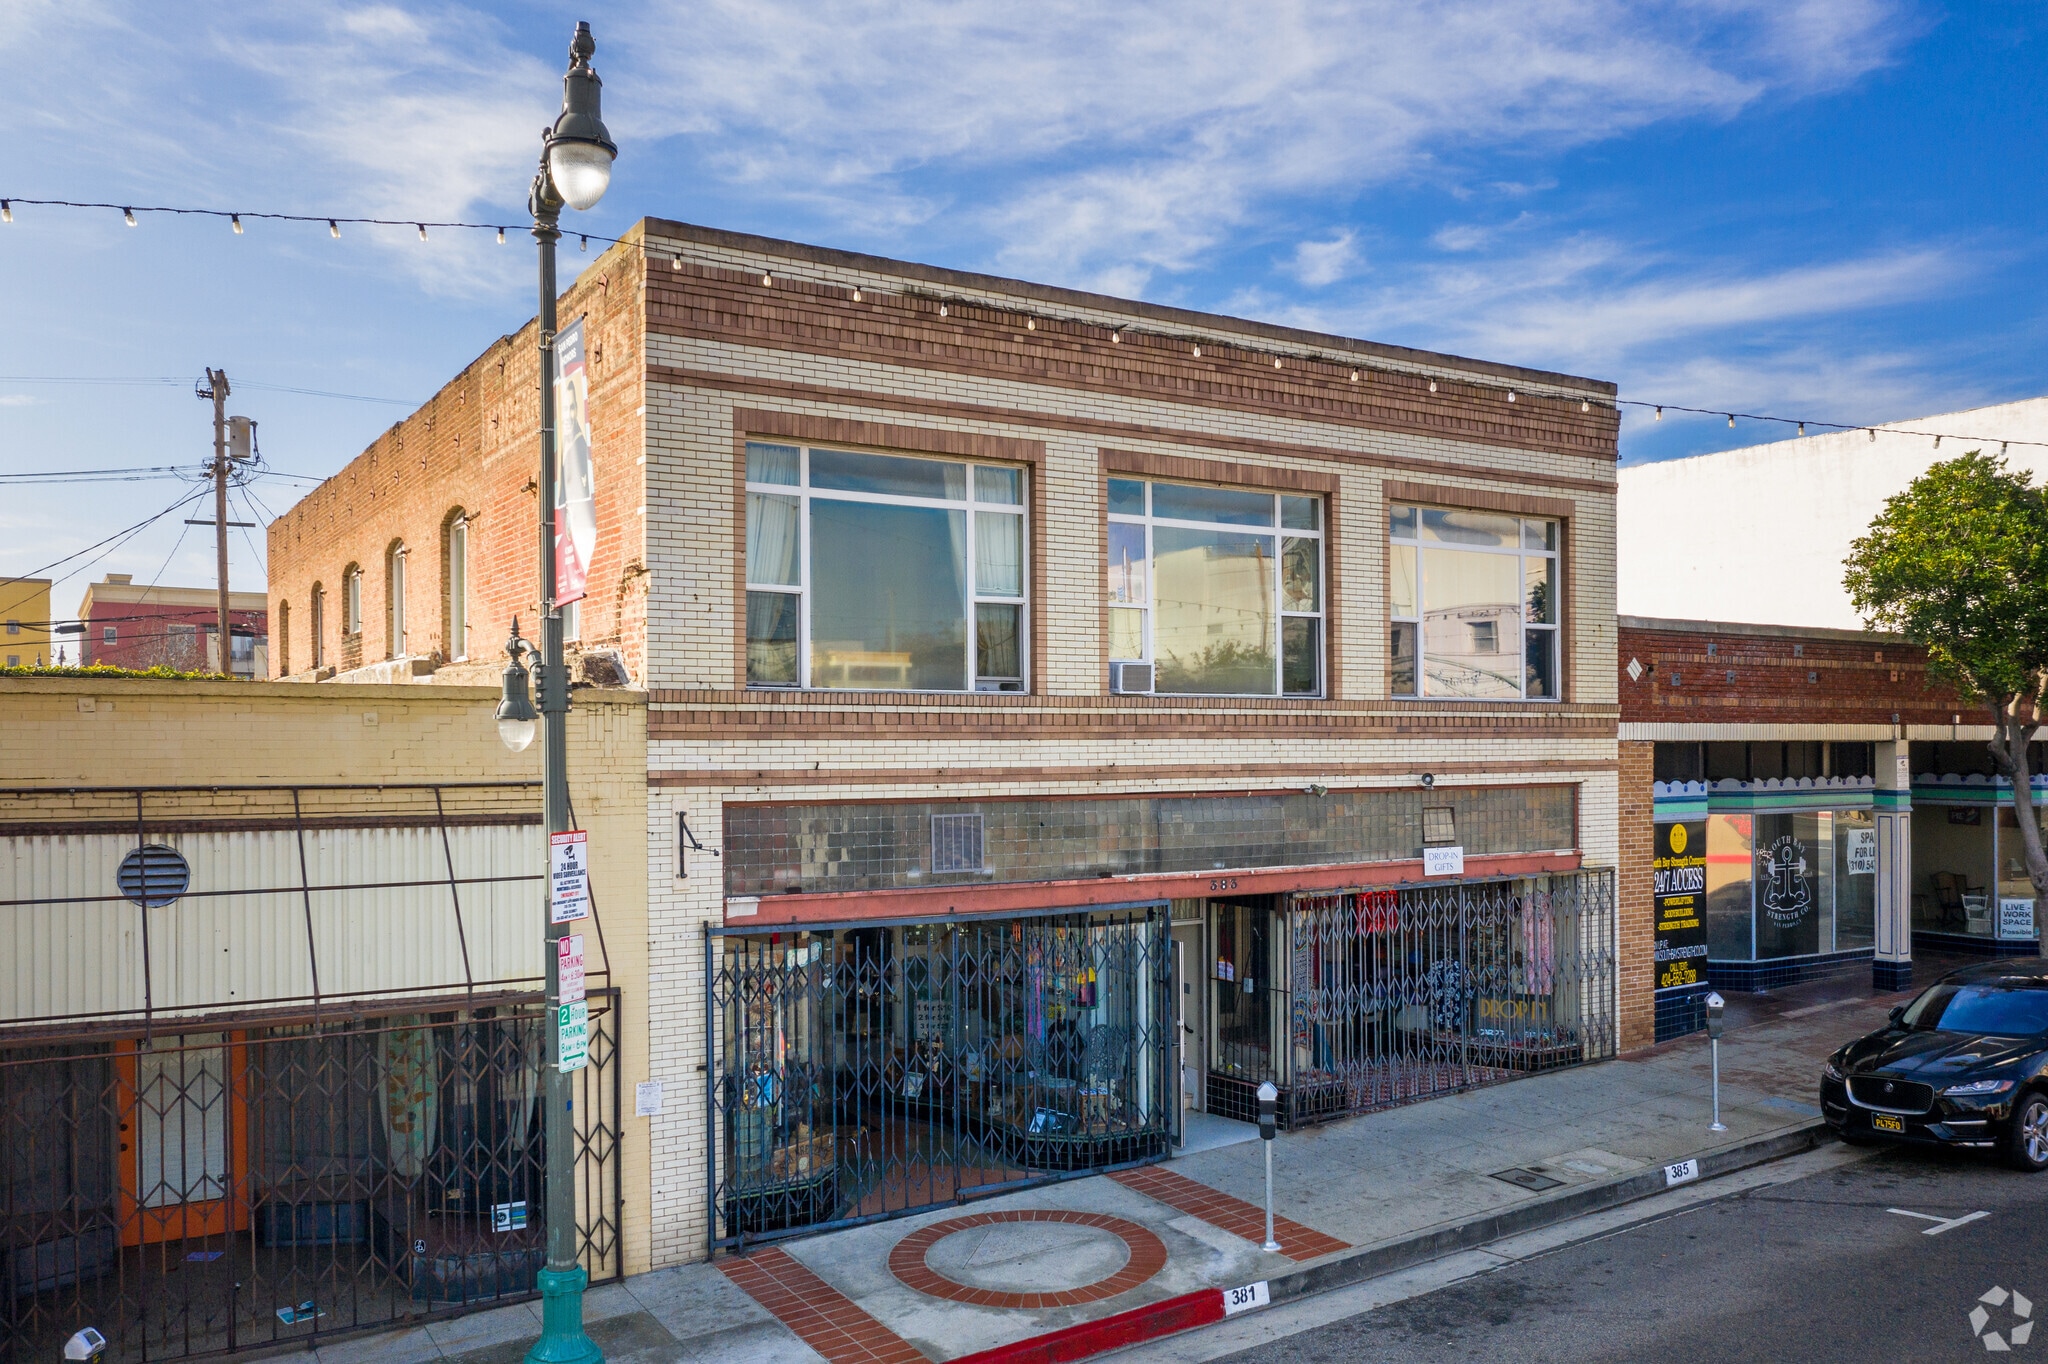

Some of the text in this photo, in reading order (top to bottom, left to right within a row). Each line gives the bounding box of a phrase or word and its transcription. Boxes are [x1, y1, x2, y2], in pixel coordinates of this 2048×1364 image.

[552, 832, 586, 845] SECURITY ALERT
[1428, 851, 1459, 861] DROP-IN
[1854, 847, 1868, 858] FOR
[1434, 862, 1454, 872] GIFTS
[1670, 856, 1689, 869] Strength
[1654, 867, 1704, 893] 24/7 ACCESS
[2005, 903, 2026, 911] LIVE
[2002, 918, 2032, 926] SPACE
[560, 939, 570, 956] NO
[560, 953, 583, 971] PARKING
[560, 1006, 586, 1024] 2 HOUR
[561, 1022, 586, 1040] PARKING
[1671, 1162, 1689, 1179] 385
[1232, 1285, 1256, 1305] 381
